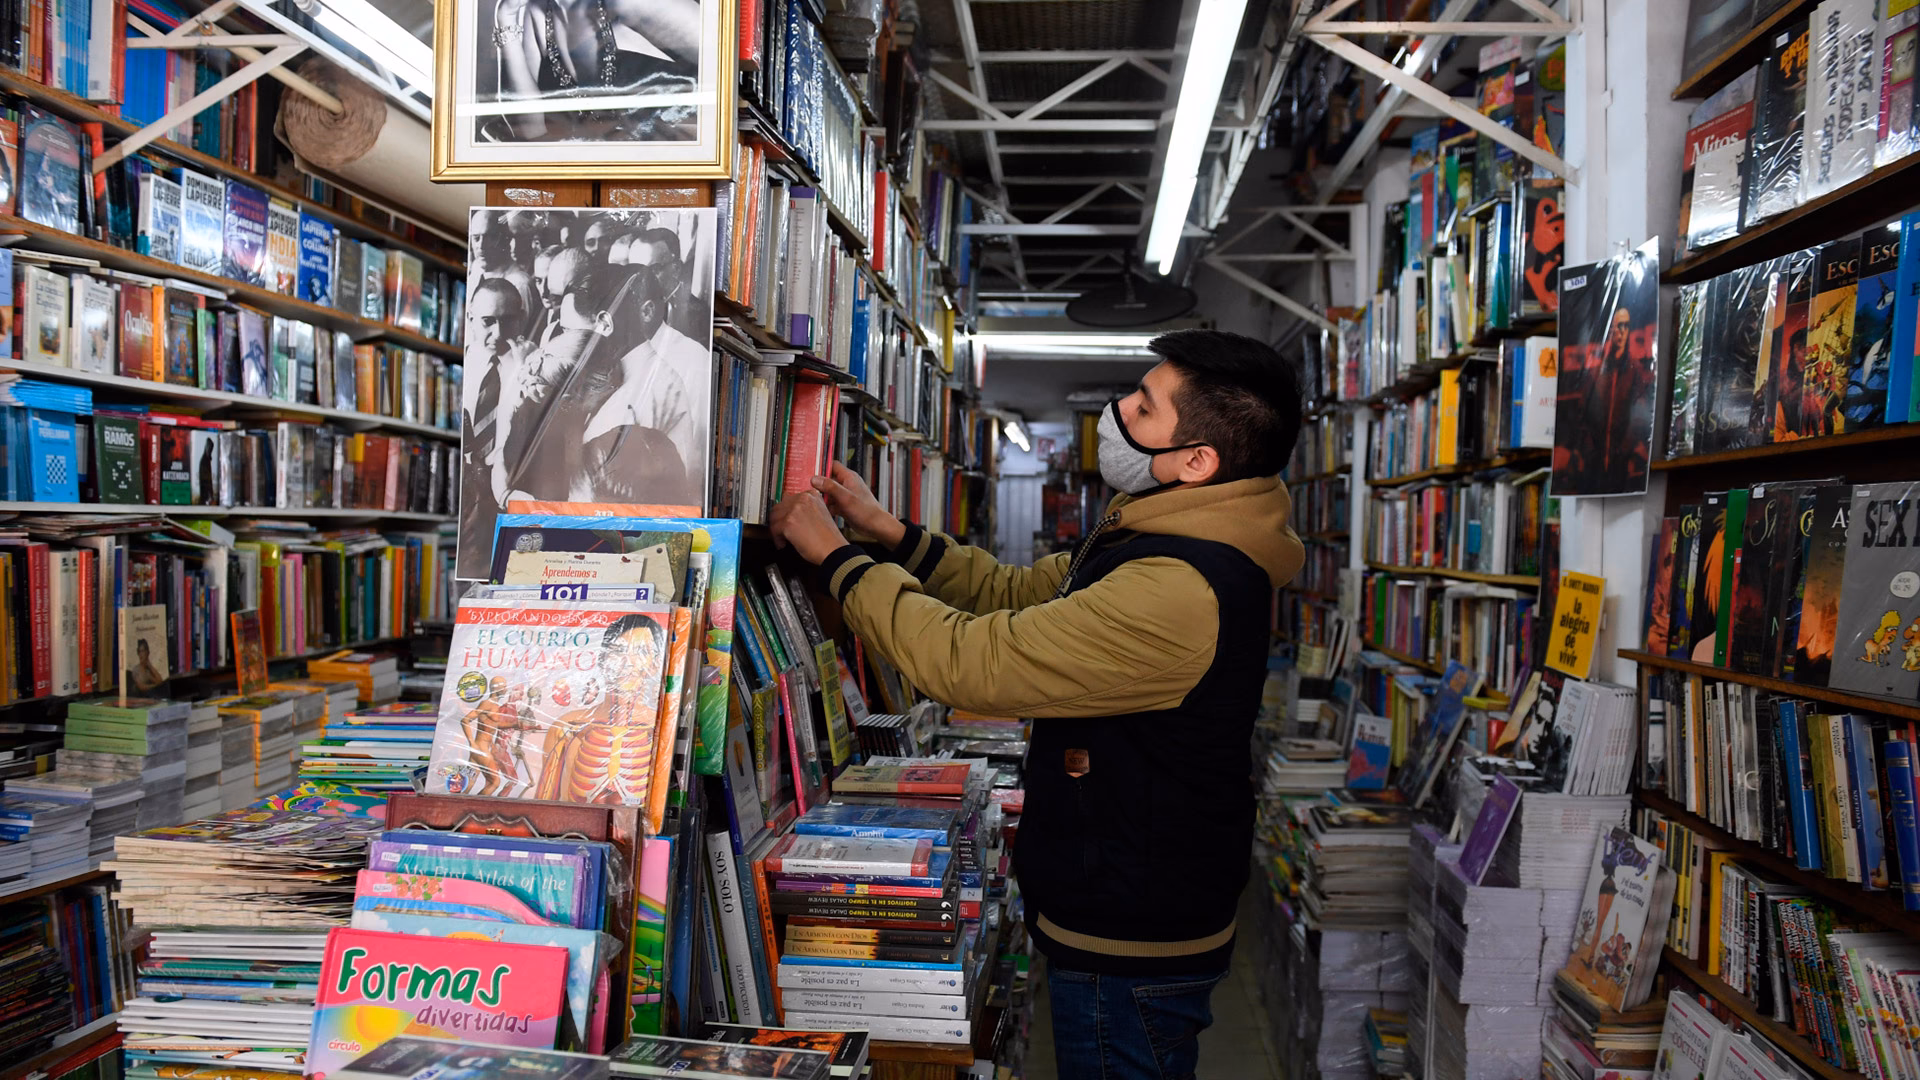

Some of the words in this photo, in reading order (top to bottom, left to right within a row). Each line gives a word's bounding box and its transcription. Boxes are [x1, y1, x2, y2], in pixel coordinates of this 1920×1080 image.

[186, 176, 222, 194] DOMINIQUE
[186, 186, 222, 211] LAPIERRE
[104, 431, 135, 447] RAMOS
[542, 565, 590, 579] Aprendemos
[591, 570, 597, 579] a
[544, 585, 583, 600] 101
[1573, 597, 1582, 615] la
[477, 629, 498, 646] EL
[504, 630, 590, 648] CUERPO
[1564, 630, 1576, 649] de
[462, 647, 597, 672] HUMANO
[1559, 649, 1578, 668] vivir
[713, 851, 728, 877] SOY
[403, 863, 431, 877] My
[433, 866, 467, 880] First
[475, 869, 514, 887] Atlas
[520, 873, 537, 892] of
[542, 874, 566, 891] the
[718, 879, 735, 913] SOLO
[848, 948, 865, 956] DIOS
[337, 947, 511, 1006] Formas
[735, 964, 744, 981] LEO
[800, 976, 826, 986] posible
[836, 977, 849, 986] paz
[850, 978, 860, 987] La
[738, 982, 751, 1016] PICCIOLI
[804, 999, 828, 1009] posible
[838, 1000, 852, 1009] paz
[853, 1002, 862, 1010] La
[416, 1005, 534, 1034] divertidas
[327, 1038, 361, 1052] círculo
